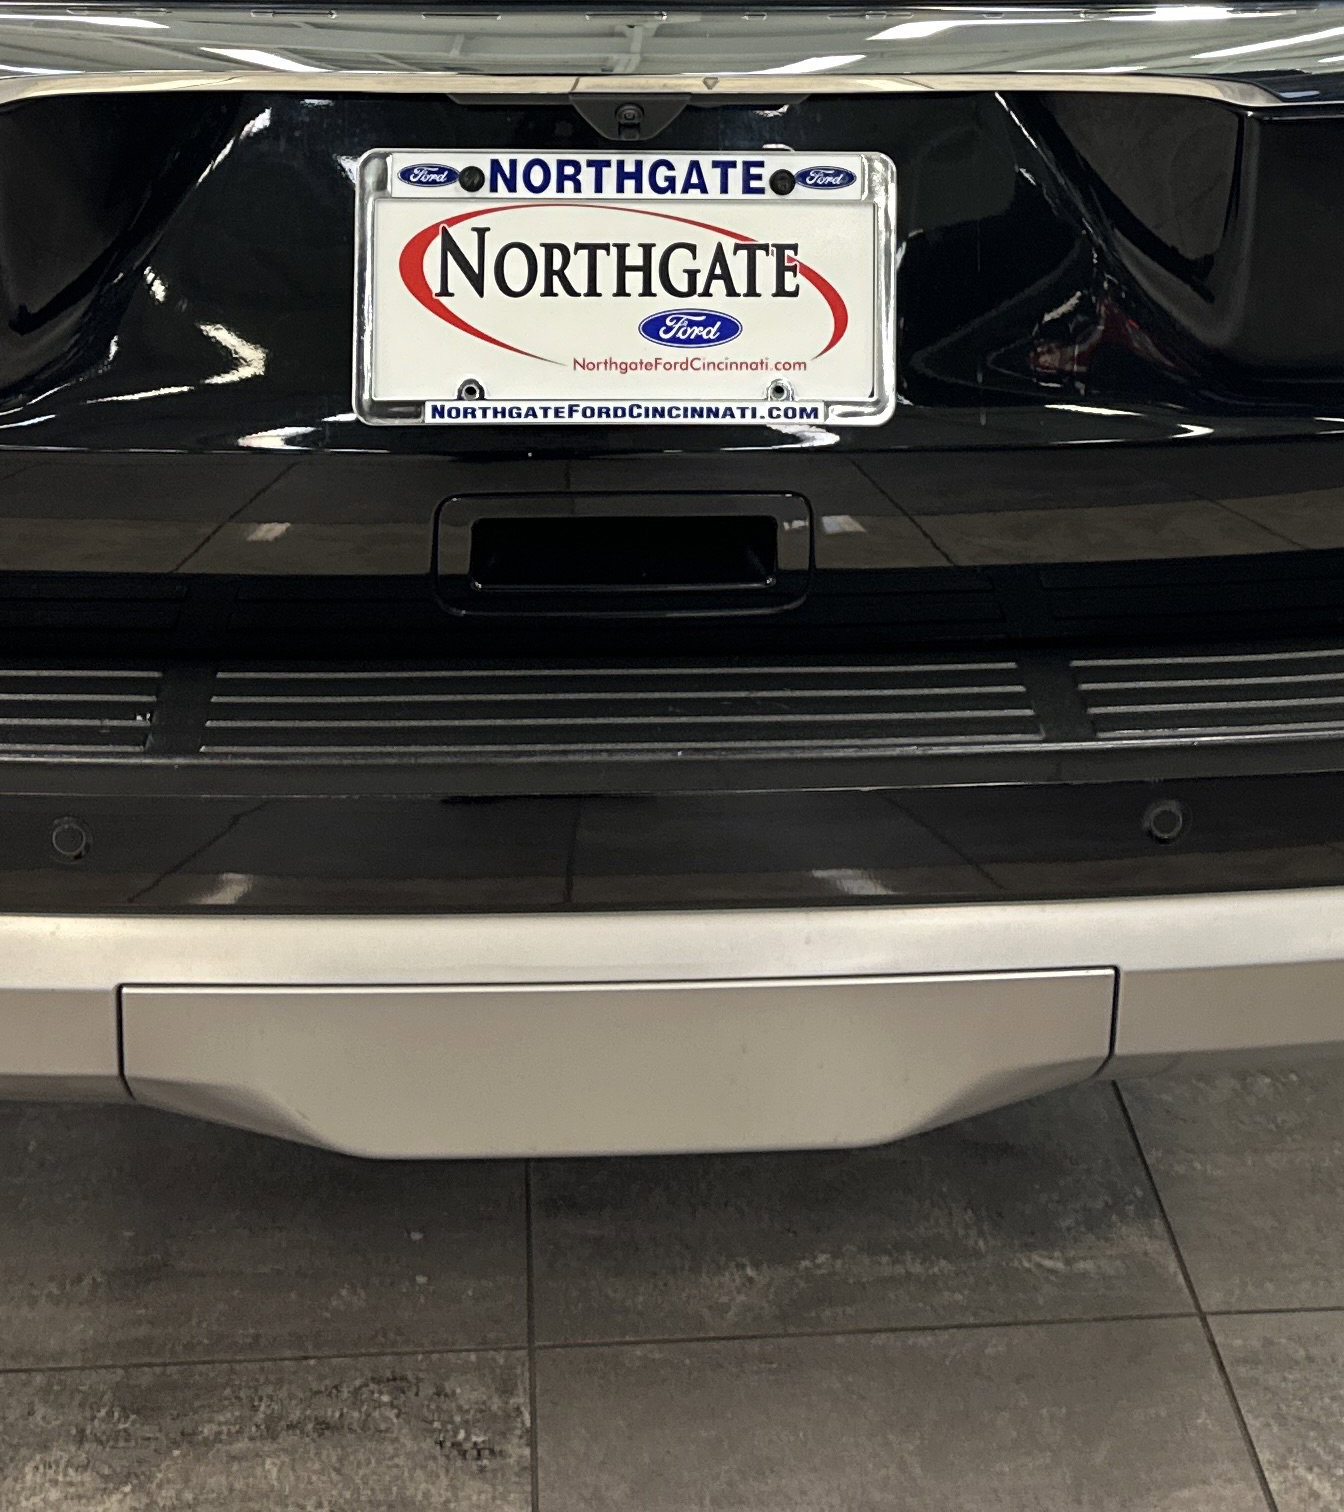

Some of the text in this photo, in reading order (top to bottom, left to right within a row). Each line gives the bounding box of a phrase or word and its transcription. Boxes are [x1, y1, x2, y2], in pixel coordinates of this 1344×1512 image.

[409, 166, 448, 183] Ford
[488, 157, 766, 195] NORTHGATE
[805, 169, 845, 185] Ford
[434, 226, 801, 299] NORTHGATE
[659, 314, 721, 340] Ford
[573, 357, 807, 375] NorthgateFordCincinnati.com
